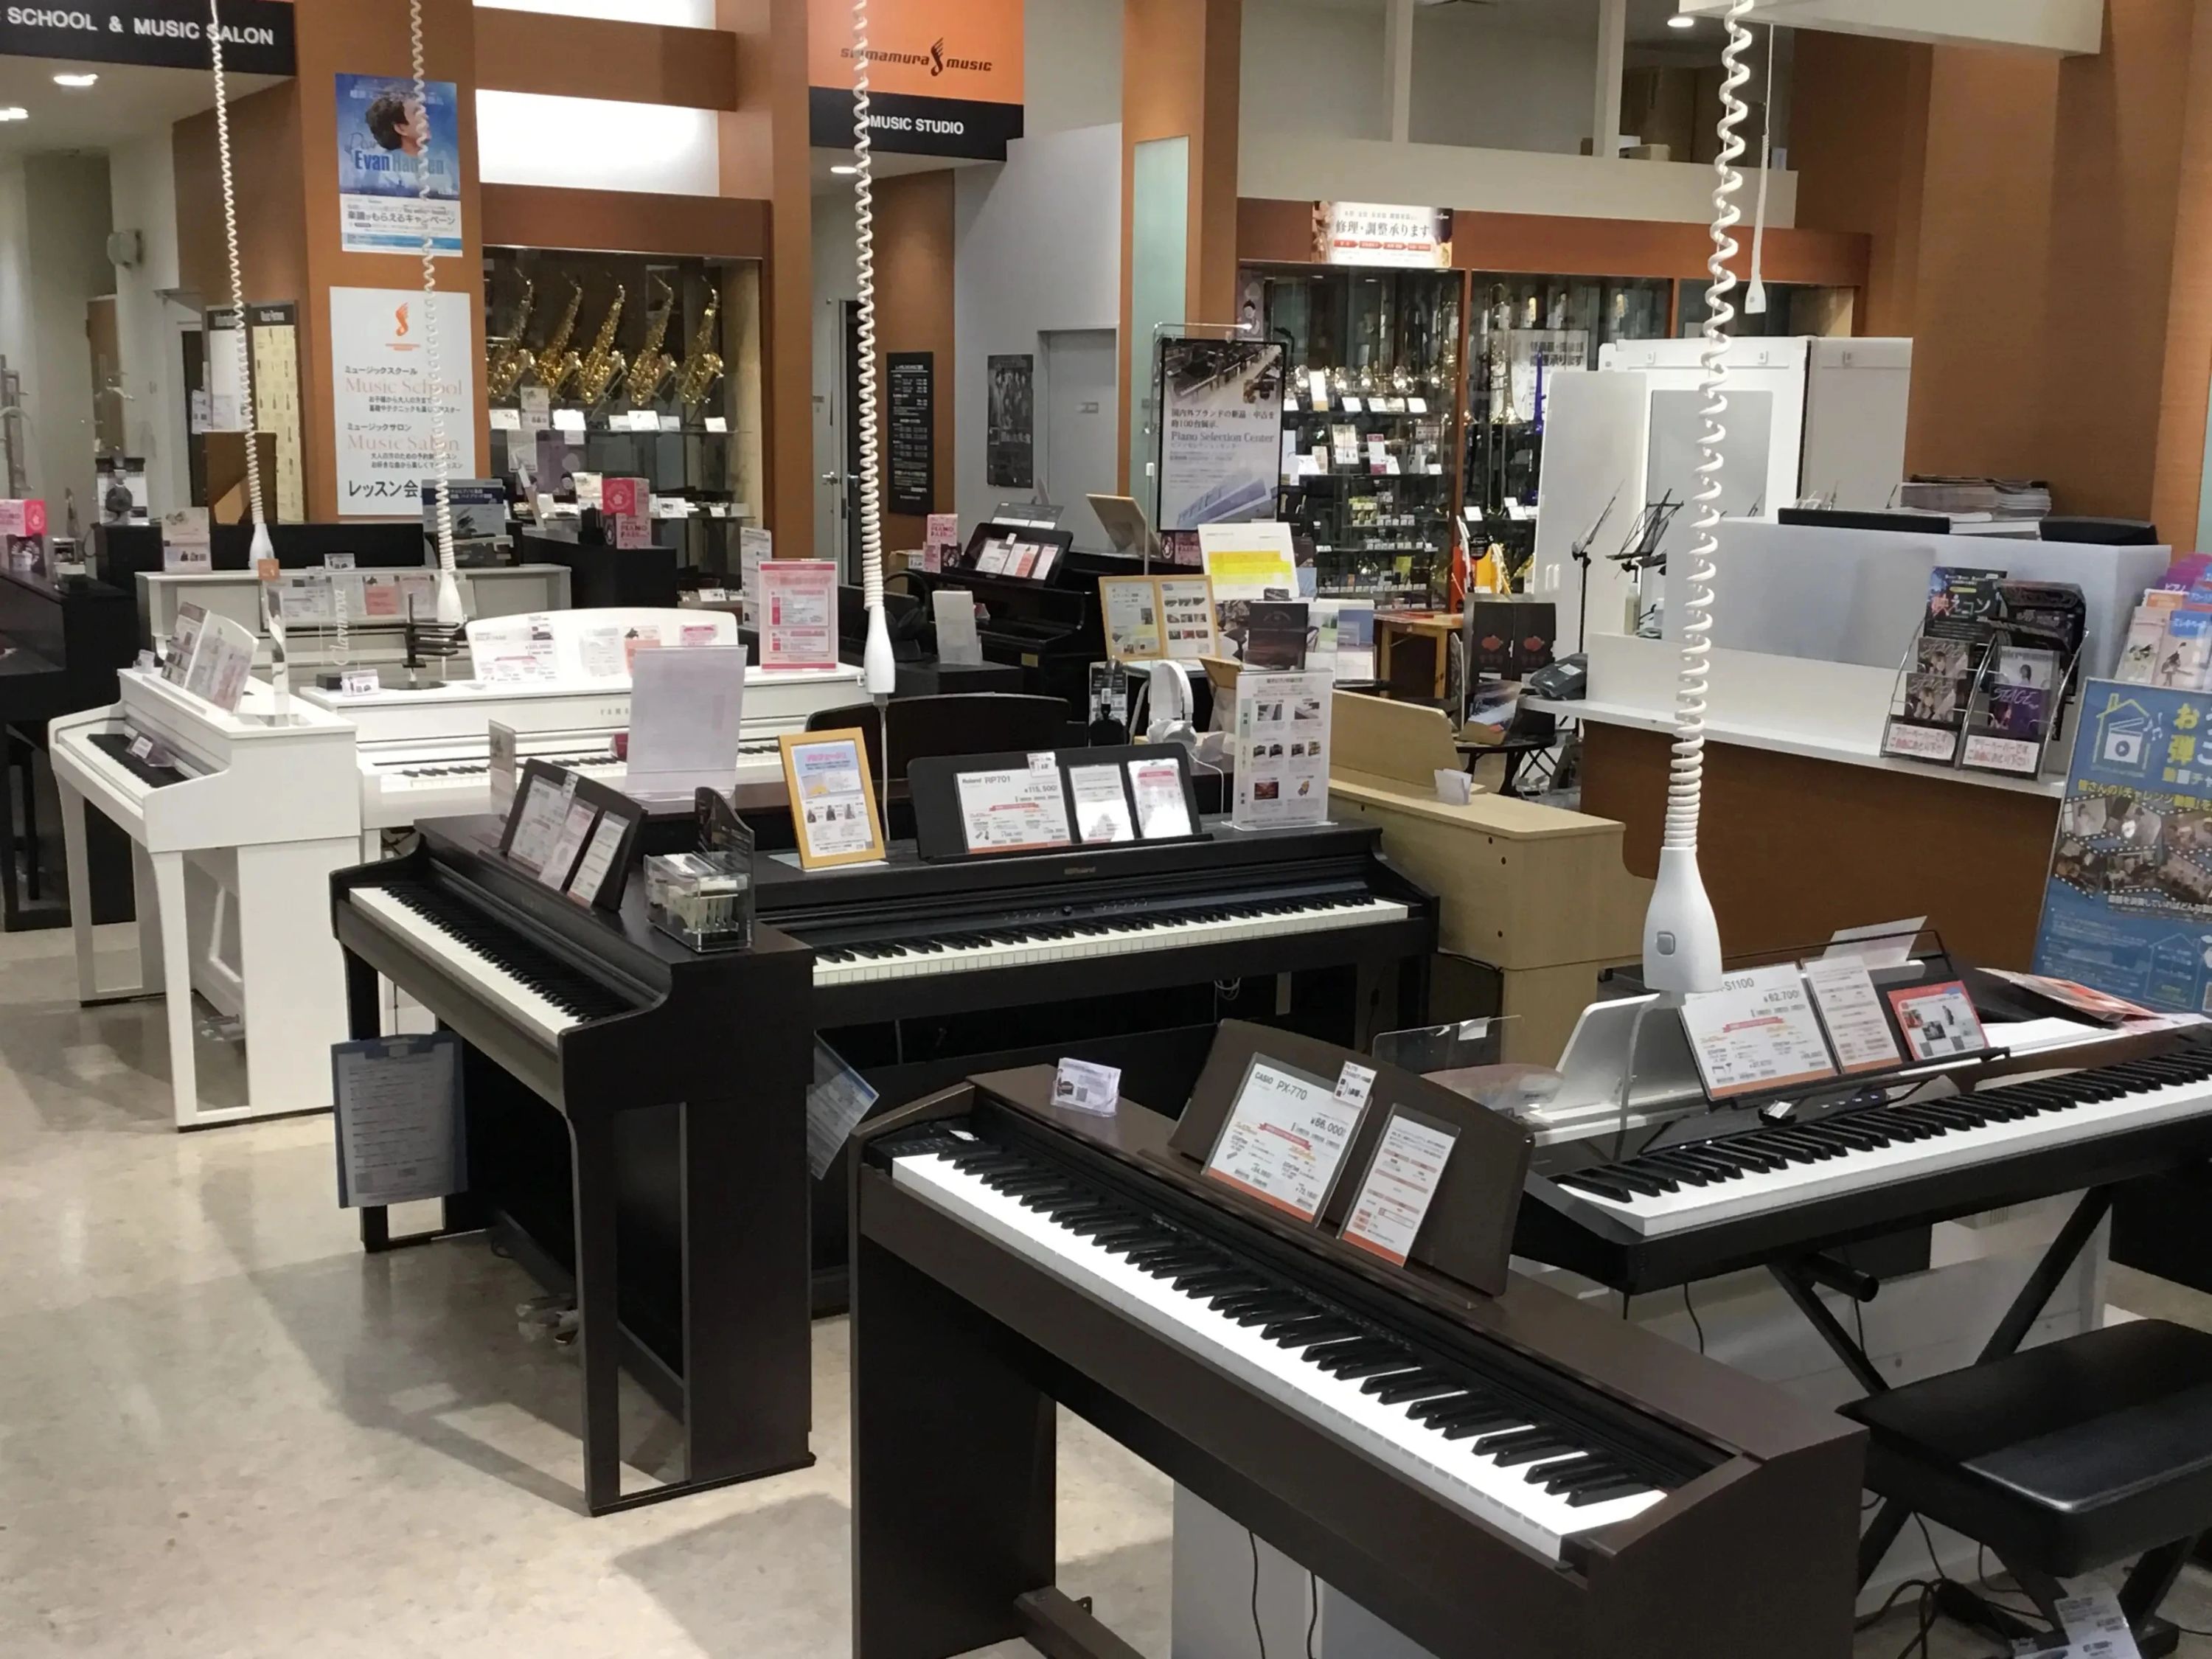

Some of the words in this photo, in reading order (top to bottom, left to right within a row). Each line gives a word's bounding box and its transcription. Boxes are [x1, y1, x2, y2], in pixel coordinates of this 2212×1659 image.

[7, 7, 98, 31] SCHOOL
[108, 15, 124, 33] &
[134, 18, 201, 40] MUSIC
[207, 23, 274, 46] SALON
[946, 58, 993, 72] music
[870, 115, 912, 131] MUSIC
[915, 119, 964, 135] STUDIO
[355, 150, 391, 172] Evan
[392, 156, 445, 175] Hanen
[1335, 220, 1430, 238] 修理・調整承ります
[344, 366, 418, 375] ミュージックスクール
[345, 378, 397, 394] Music
[347, 422, 411, 431] ミュージックサロン
[347, 434, 399, 451] Music
[1171, 431, 1197, 442] Piano
[1200, 432, 1241, 442] Selection
[1244, 433, 1274, 442] Center
[348, 480, 422, 498] レッスン会
[331, 588, 349, 666] Clavinova
[1992, 689, 2035, 706] STAGE
[985, 776, 1011, 785] RP701
[1719, 977, 1755, 992] -S1100
[1255, 1071, 1274, 1085] CASIO
[1276, 1079, 1308, 1101] PX-770
